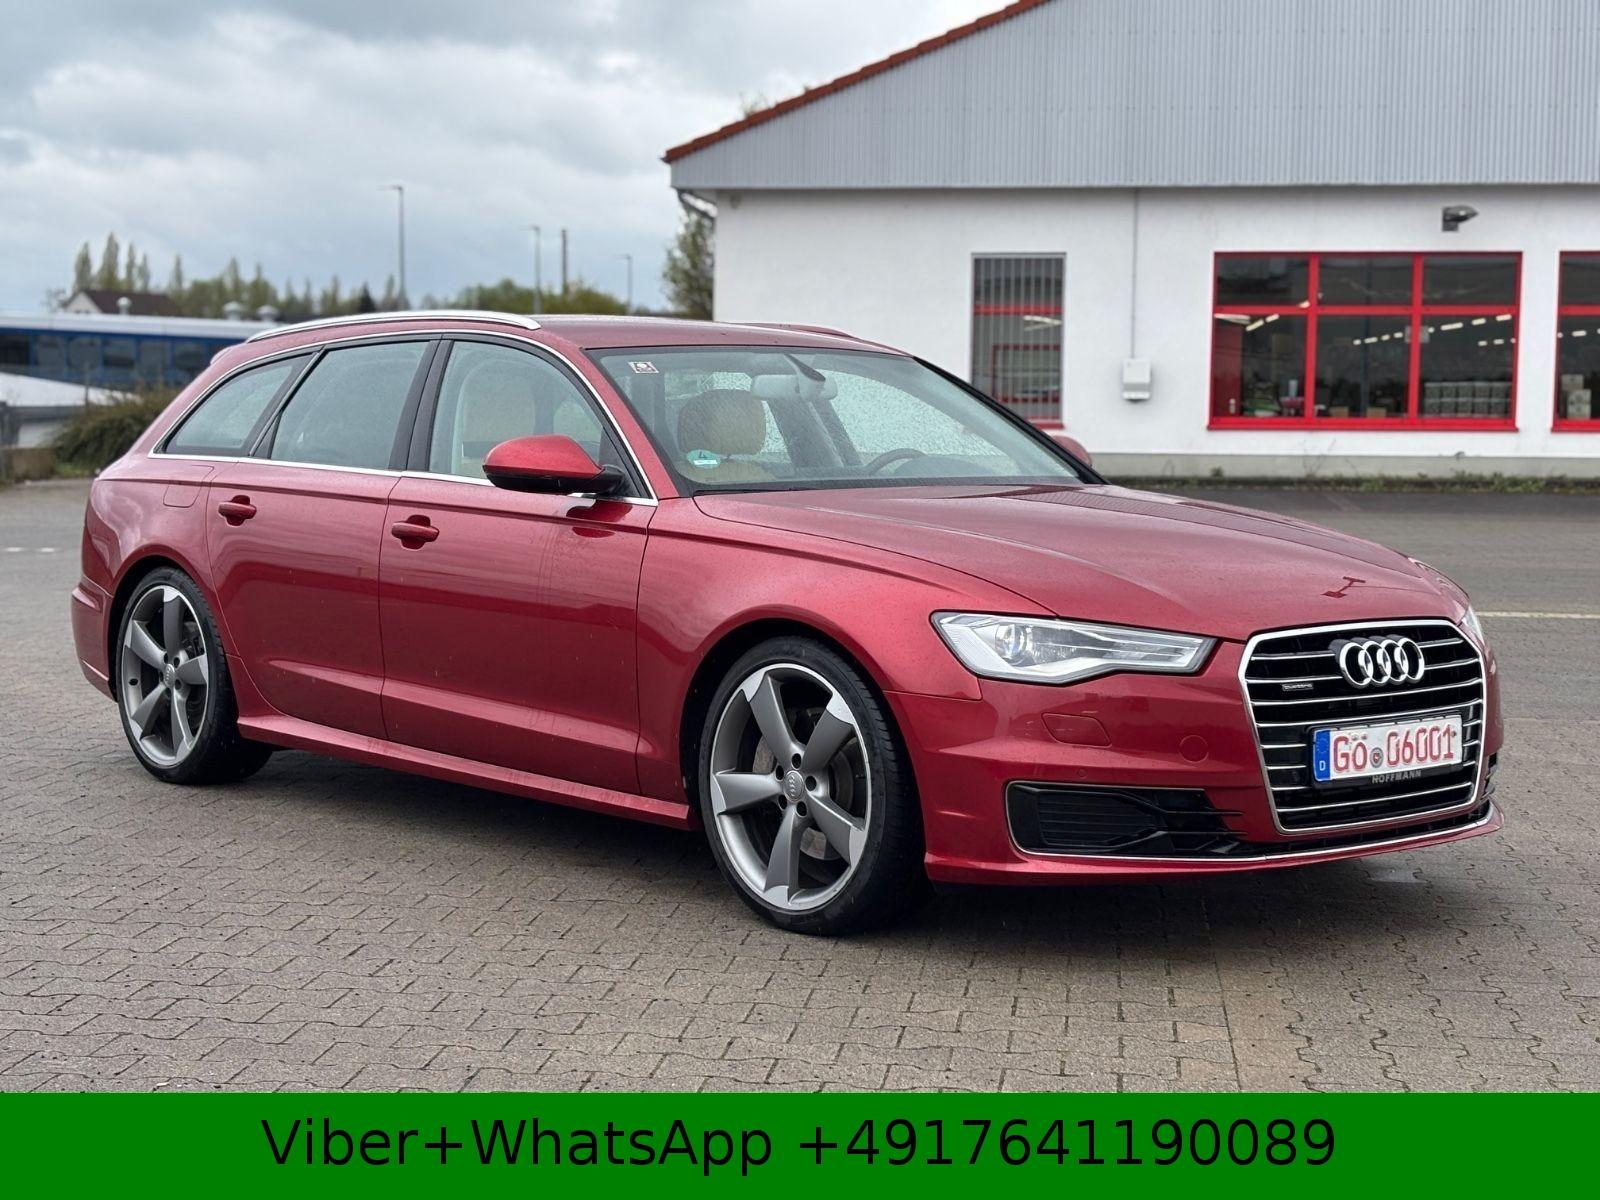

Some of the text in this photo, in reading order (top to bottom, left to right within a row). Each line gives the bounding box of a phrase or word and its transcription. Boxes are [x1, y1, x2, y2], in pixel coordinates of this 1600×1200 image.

[1319, 724, 1454, 772] D GÖ 06001
[1372, 770, 1422, 784] HOFFMANN
